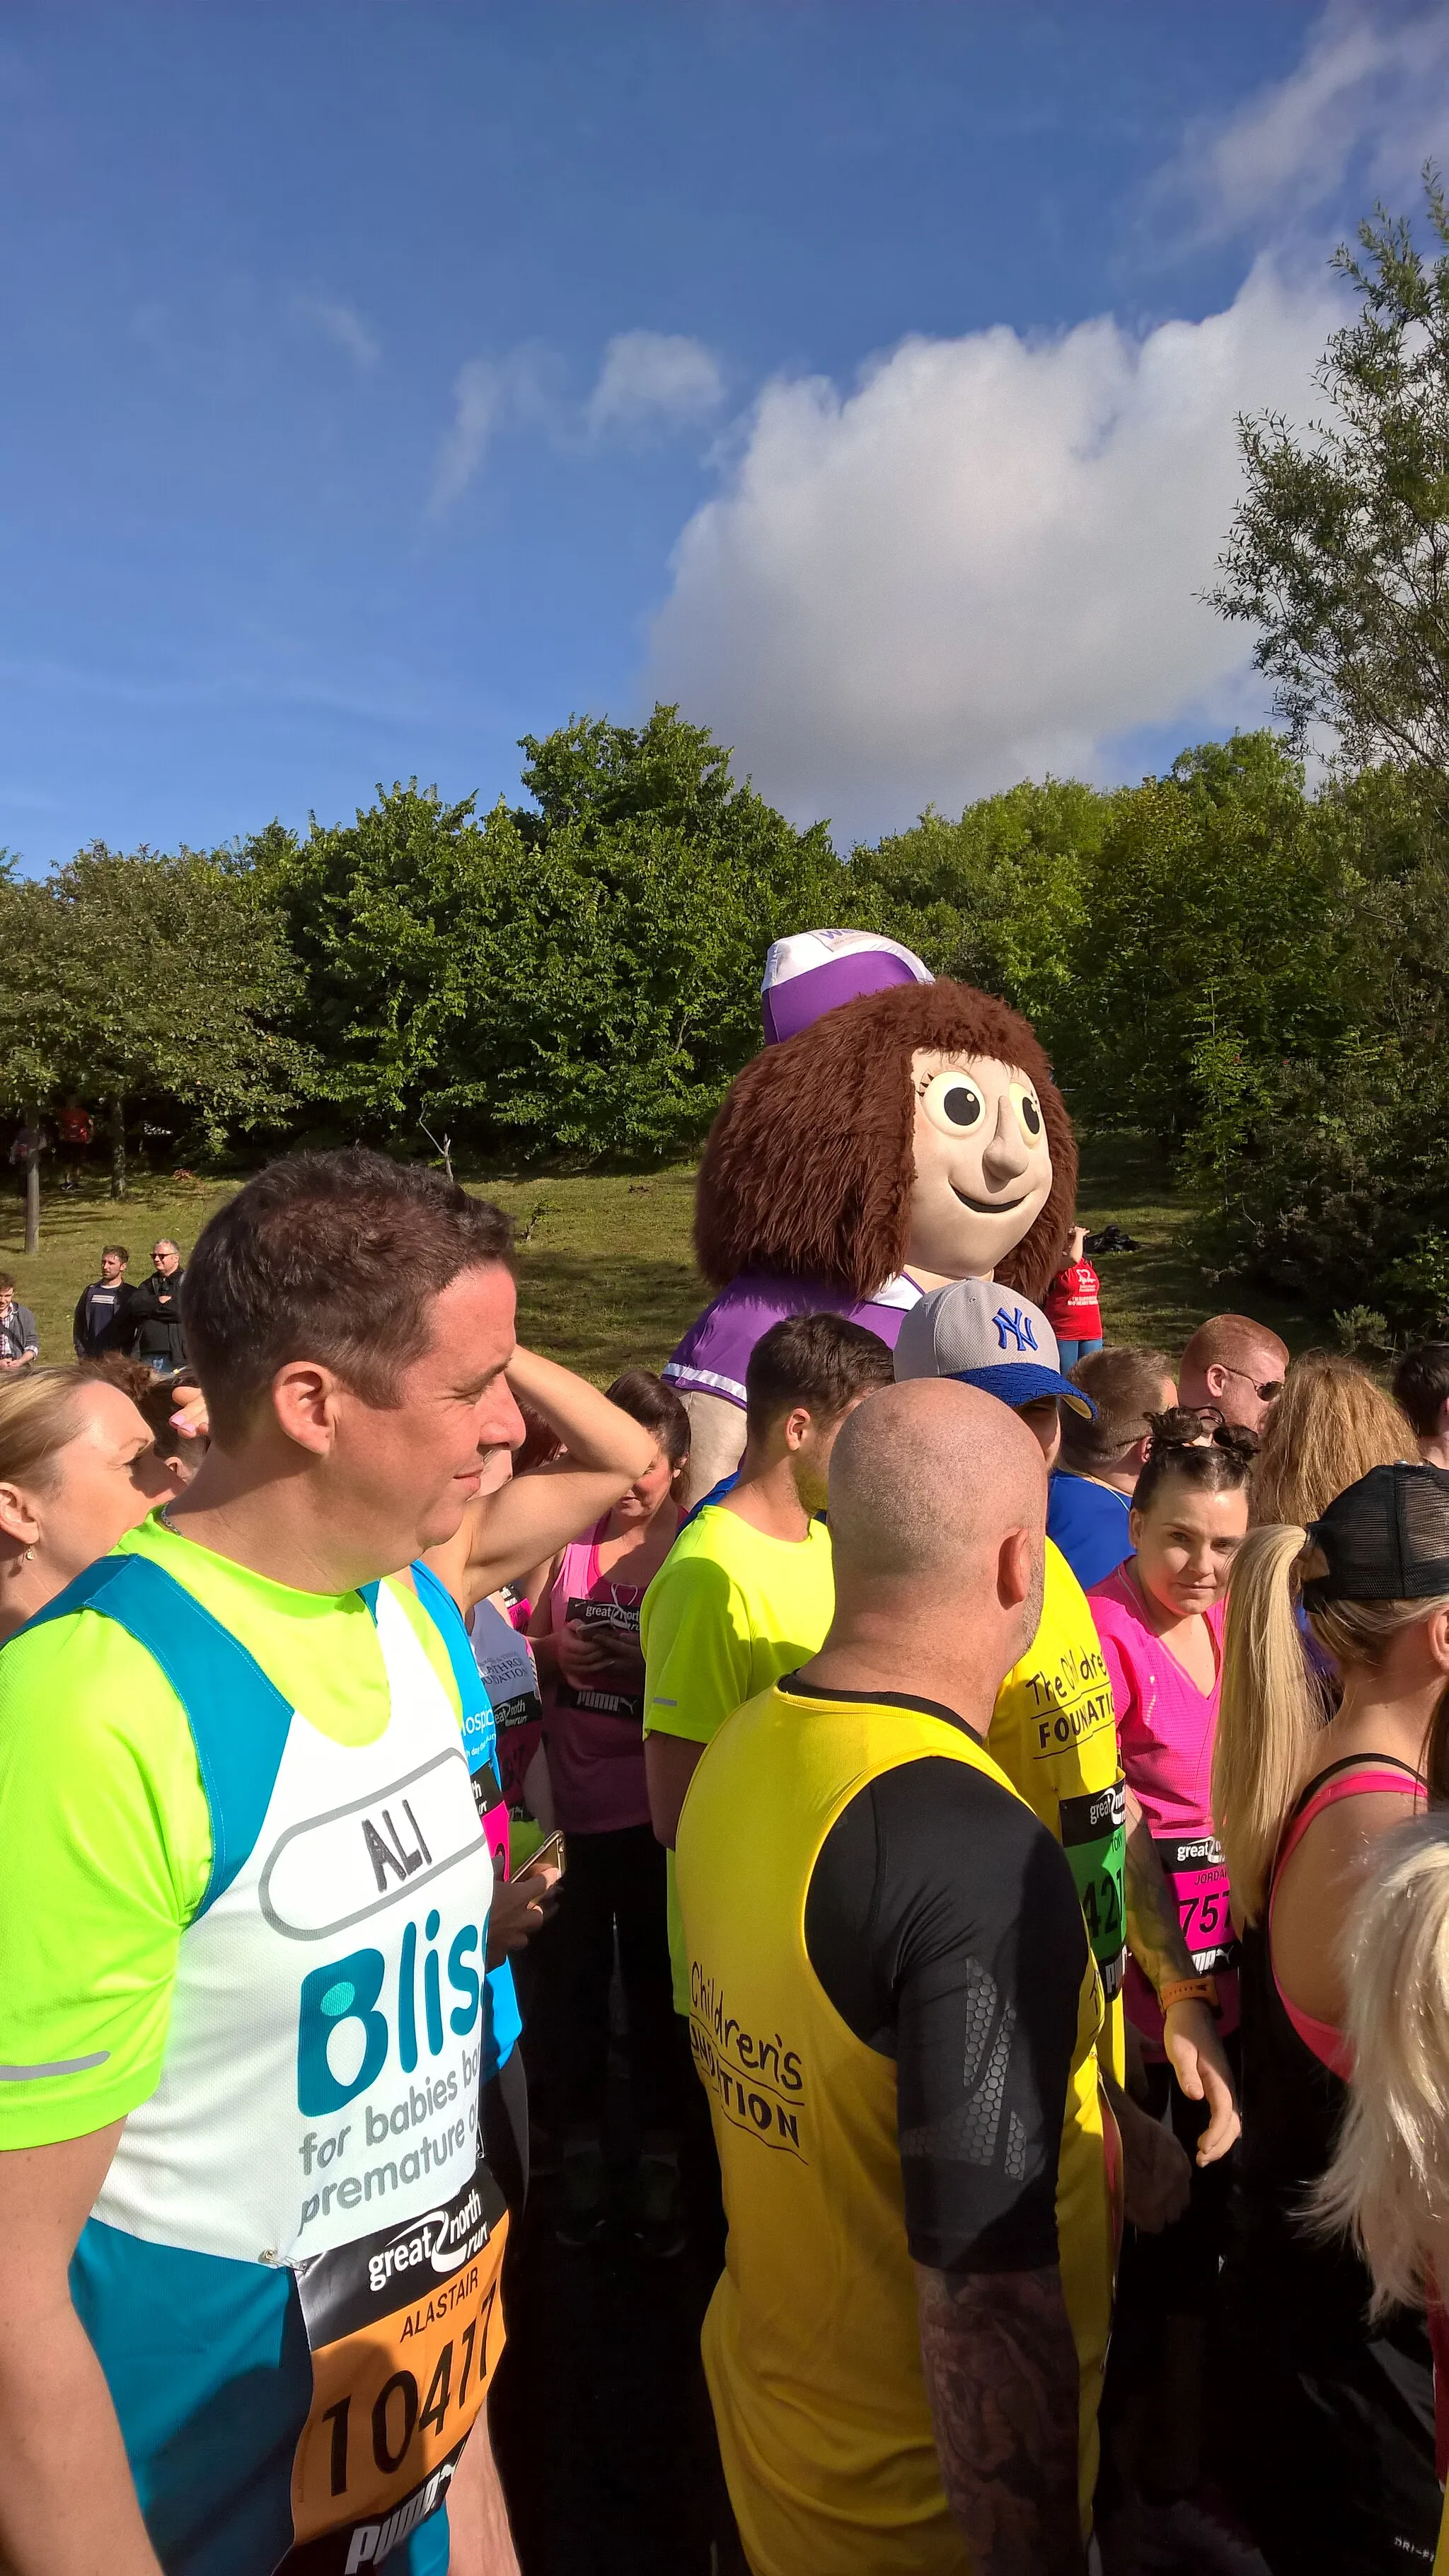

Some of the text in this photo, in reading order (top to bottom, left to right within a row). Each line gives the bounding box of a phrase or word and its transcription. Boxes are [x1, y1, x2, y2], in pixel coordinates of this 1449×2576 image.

[991, 1307, 1039, 1351] NY
[585, 1605, 611, 1617] great
[1025, 1670, 1067, 1706] The
[362, 1799, 432, 1893] ALI
[1177, 1844, 1208, 1861] great
[1194, 1869, 1227, 1886] JORDA
[691, 1960, 803, 2091] Children's
[299, 2125, 352, 2176] for
[365, 2070, 458, 2147] babies
[297, 2118, 466, 2238] premature
[368, 2188, 482, 2292] great north
[466, 2220, 487, 2260] run
[400, 2266, 479, 2343] ALASTAIR
